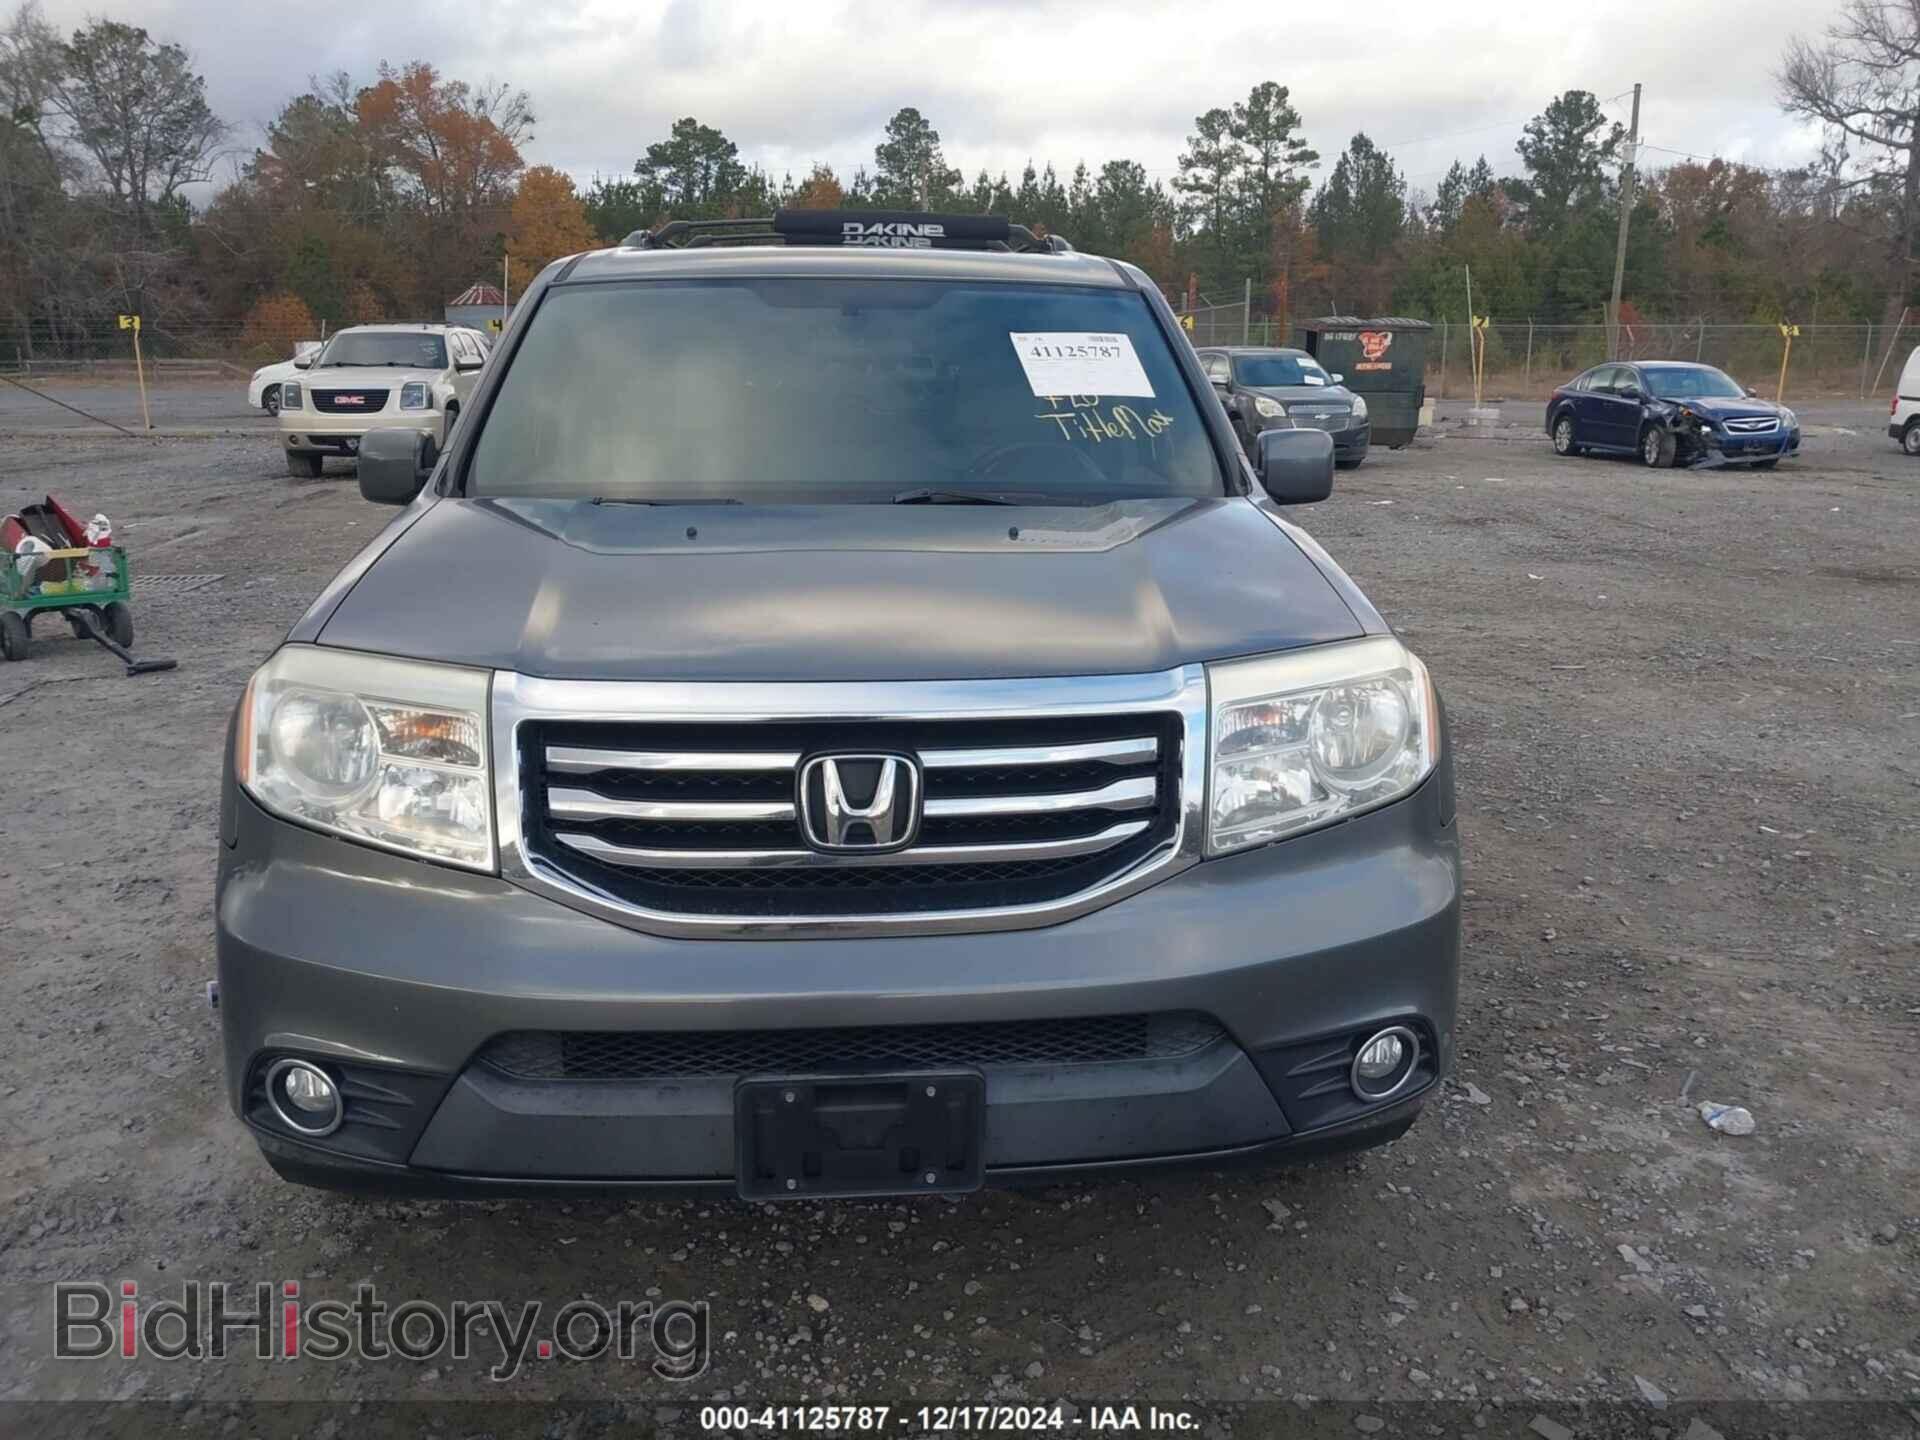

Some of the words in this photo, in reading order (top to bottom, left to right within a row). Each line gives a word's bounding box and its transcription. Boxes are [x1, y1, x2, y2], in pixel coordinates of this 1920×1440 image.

[841, 222, 946, 237] DAKINE
[1030, 345, 1121, 359] 41125787
[334, 396, 365, 404] GMC
